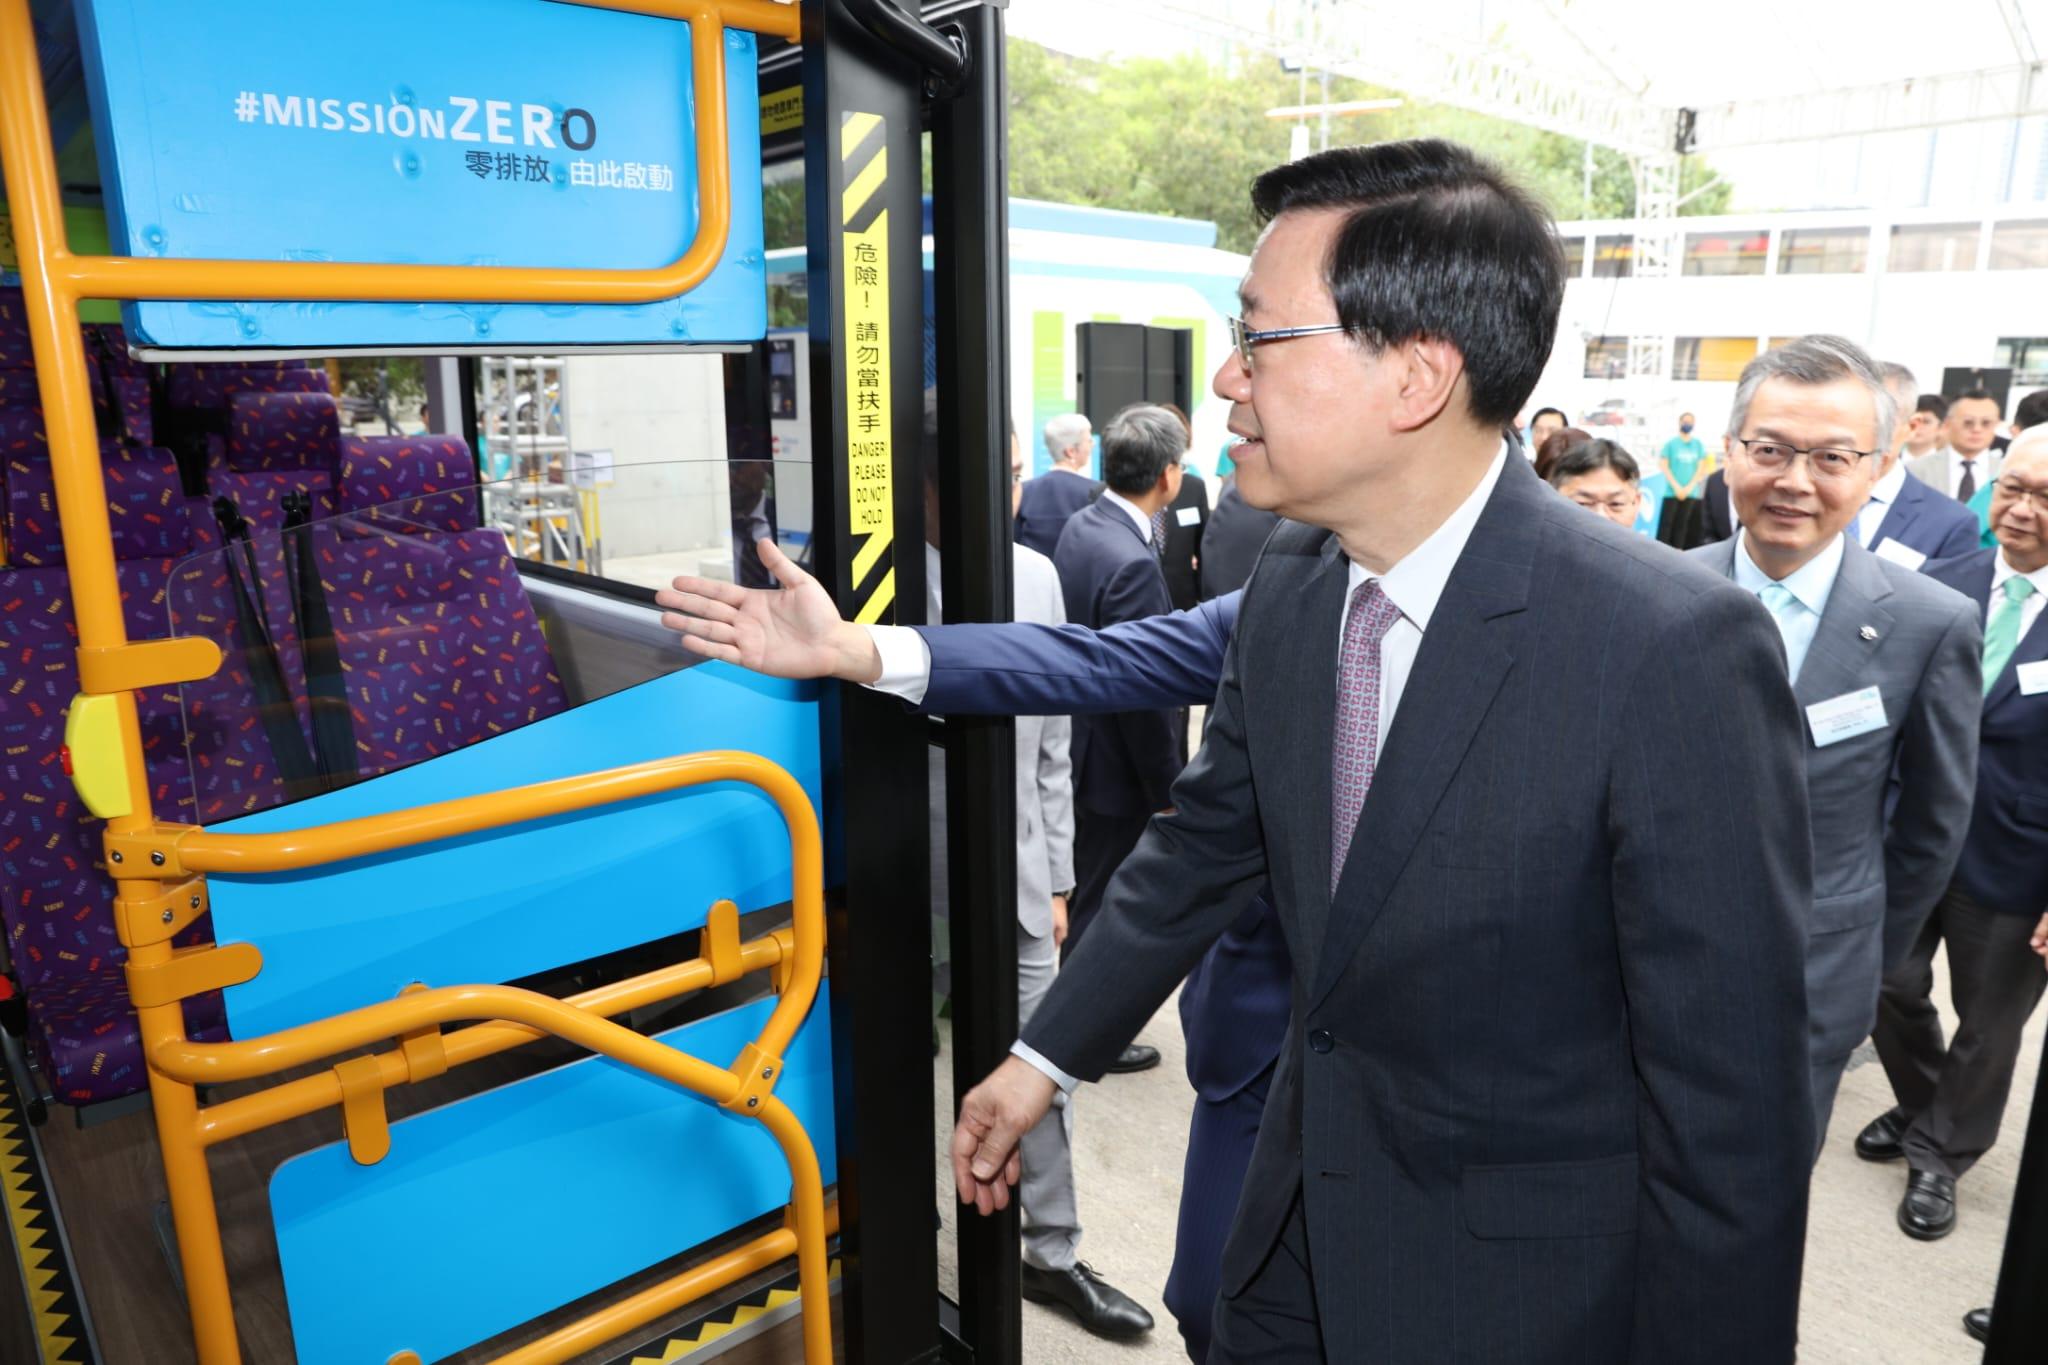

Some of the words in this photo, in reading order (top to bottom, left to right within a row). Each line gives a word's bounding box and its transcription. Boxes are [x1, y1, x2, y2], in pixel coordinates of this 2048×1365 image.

[464, 149, 551, 183] 零排放
[569, 159, 674, 192] 由此啟動
[855, 321, 881, 434] 請勿當扶手
[855, 463, 886, 480] PLEASE
[856, 488, 868, 503] DO
[870, 486, 886, 502] NOT
[861, 508, 883, 525] HOLD
